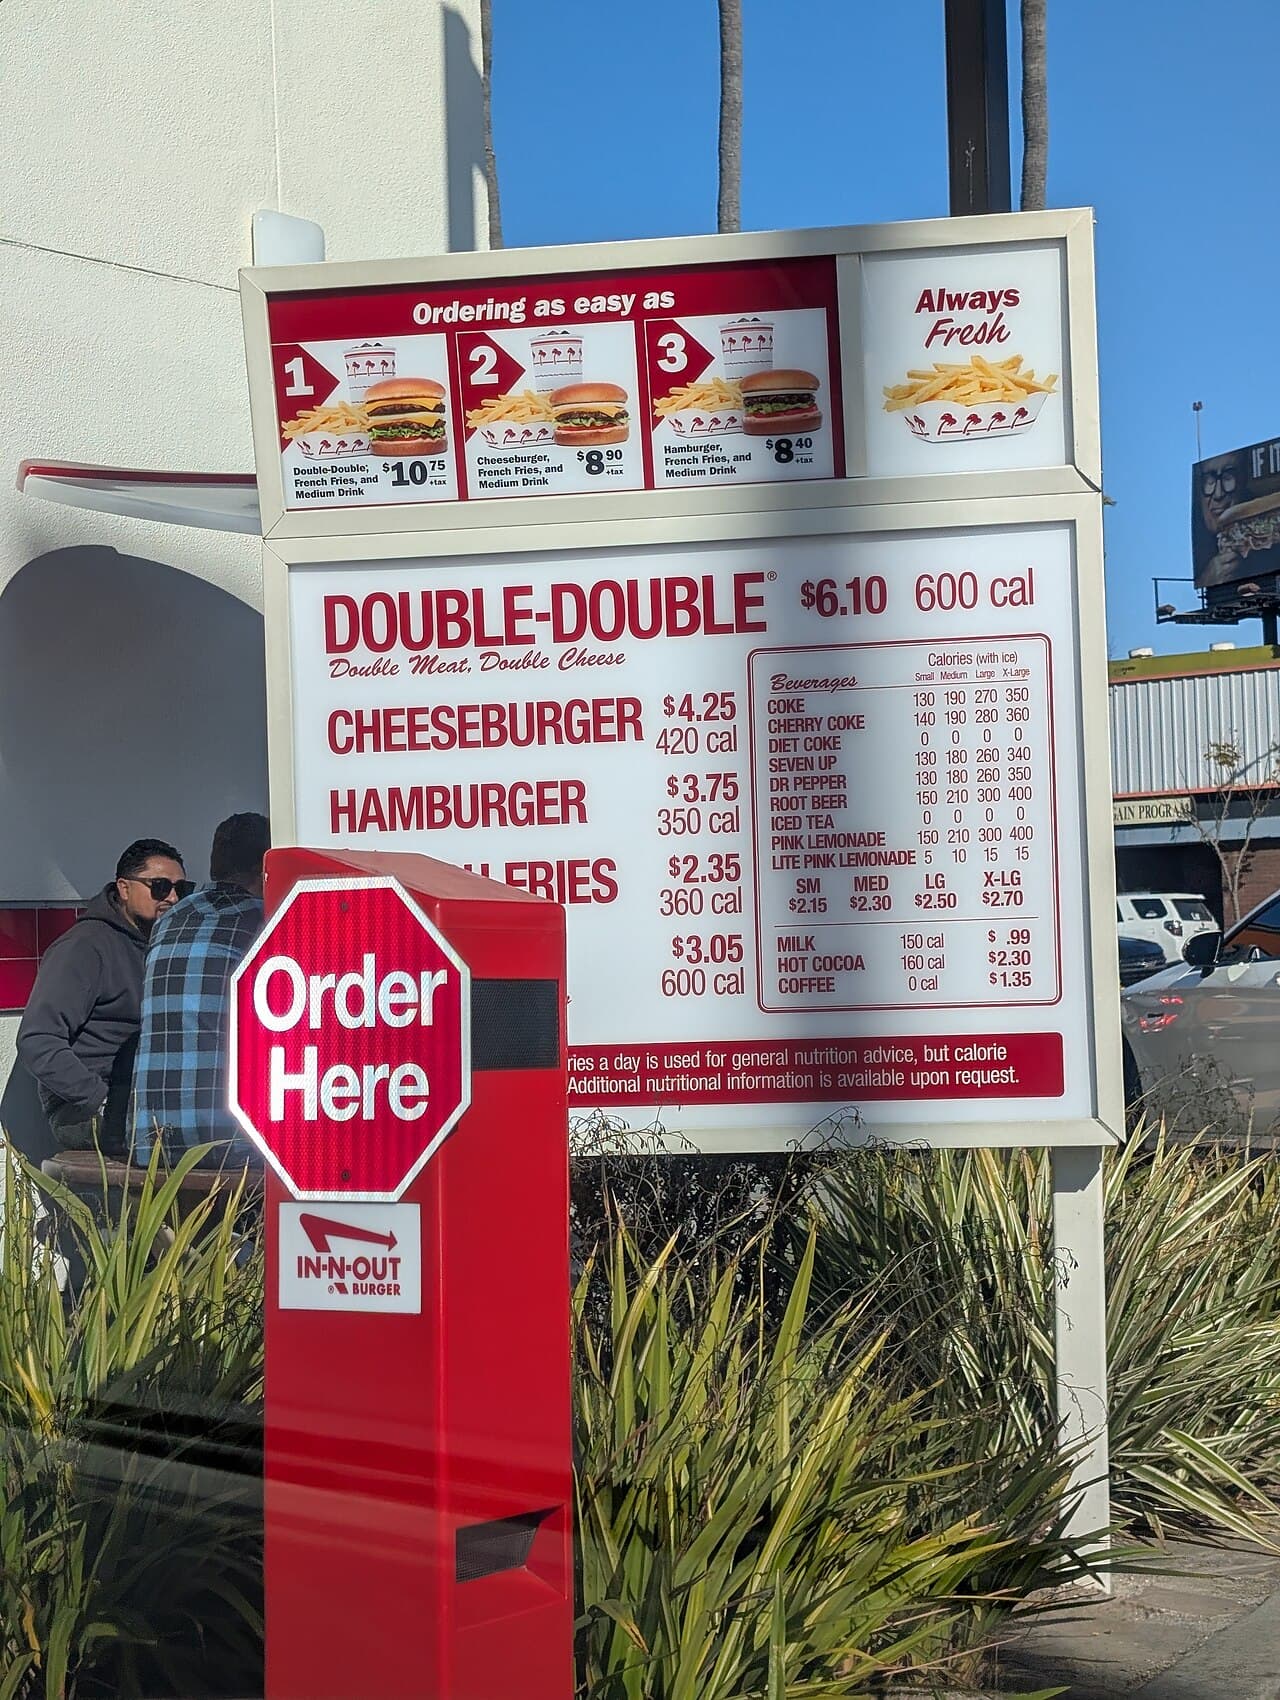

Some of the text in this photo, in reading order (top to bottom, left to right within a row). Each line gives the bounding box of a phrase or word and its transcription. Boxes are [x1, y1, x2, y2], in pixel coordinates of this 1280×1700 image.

[413, 289, 675, 326] Ordering as easy as
[915, 287, 1020, 315] Always
[925, 312, 1011, 348] Fresh
[656, 333, 689, 373] 3
[468, 345, 500, 386] 2
[284, 357, 315, 397] 1
[664, 443, 723, 454] Hamburger,
[477, 454, 550, 466] Cheeseburger,
[665, 452, 752, 466] French Fries, and
[1252, 447, 1265, 478] IF
[478, 464, 563, 477] French Fries, and
[665, 465, 737, 478] Medium Drink
[294, 475, 378, 487] French Fries, and
[479, 477, 549, 489] Medium Drink
[295, 487, 365, 499] Medium Drink
[801, 575, 888, 618] $6.10
[915, 571, 979, 612] 600
[990, 567, 1034, 608] cal
[329, 646, 626, 679] Double Meat, Double Cheese
[928, 652, 973, 667] Calories
[976, 652, 999, 666] (with
[770, 673, 858, 693] Beverages
[915, 668, 1030, 681] Small Medium Large X-Large
[768, 698, 805, 714] COKE
[913, 687, 1029, 707] 130 190 270 350
[327, 692, 737, 755] CHEESEBURGER $4.25
[768, 715, 865, 734] CHERRY COKE
[914, 707, 1030, 726] 140 190 280 360
[655, 724, 738, 755] 420 cal
[768, 736, 841, 753] DIET COKE
[769, 756, 837, 773] SEVEN UP
[915, 746, 1031, 766] 130 180 260 340
[770, 775, 847, 792] DR PEPPER
[916, 766, 1031, 785] 130 180 260 350
[330, 772, 739, 834] HAMBURGER $3.75
[770, 794, 848, 812] ROOT BEER
[916, 786, 1032, 805] 150 210 300 400
[657, 805, 741, 835] 350 cal
[771, 814, 834, 831] ICED TEA
[771, 832, 886, 850] PINK LEMONADE
[917, 826, 1033, 845] 150 210 300 400
[772, 850, 916, 870] LITE PINK LEMONADE
[505, 853, 741, 904] FRIES $2.35
[796, 870, 1021, 894] SM MED LG X-LG
[659, 886, 742, 917] 360 cal
[788, 890, 1023, 914] $2.15 $2.30 $2.50 $2.70
[672, 934, 743, 964] $3.05
[777, 936, 816, 952] MILK
[900, 931, 944, 950] 150 cal
[778, 955, 865, 973] HOT COCOA
[900, 953, 945, 970] 160 cal
[988, 950, 1031, 967] $2.30
[662, 967, 745, 997] 600 cal
[778, 977, 835, 994] COFFEE
[920, 975, 938, 991] cal
[988, 971, 1032, 988] $1.35
[253, 953, 448, 1032] Order
[614, 1053, 640, 1073] day
[646, 1052, 659, 1069] is
[664, 1050, 700, 1069] used
[705, 1050, 727, 1067] for
[732, 1049, 788, 1070] general
[794, 1046, 858, 1066] nutrition
[863, 1045, 918, 1065] advice,
[924, 1044, 950, 1062] but
[954, 1043, 1007, 1062] calorie
[269, 1045, 430, 1123] Here
[567, 1066, 1019, 1094] Additional nutritional information is available upon request.
[297, 1255, 401, 1280] IN-N-OUT
[352, 1283, 401, 1296] BURGER
